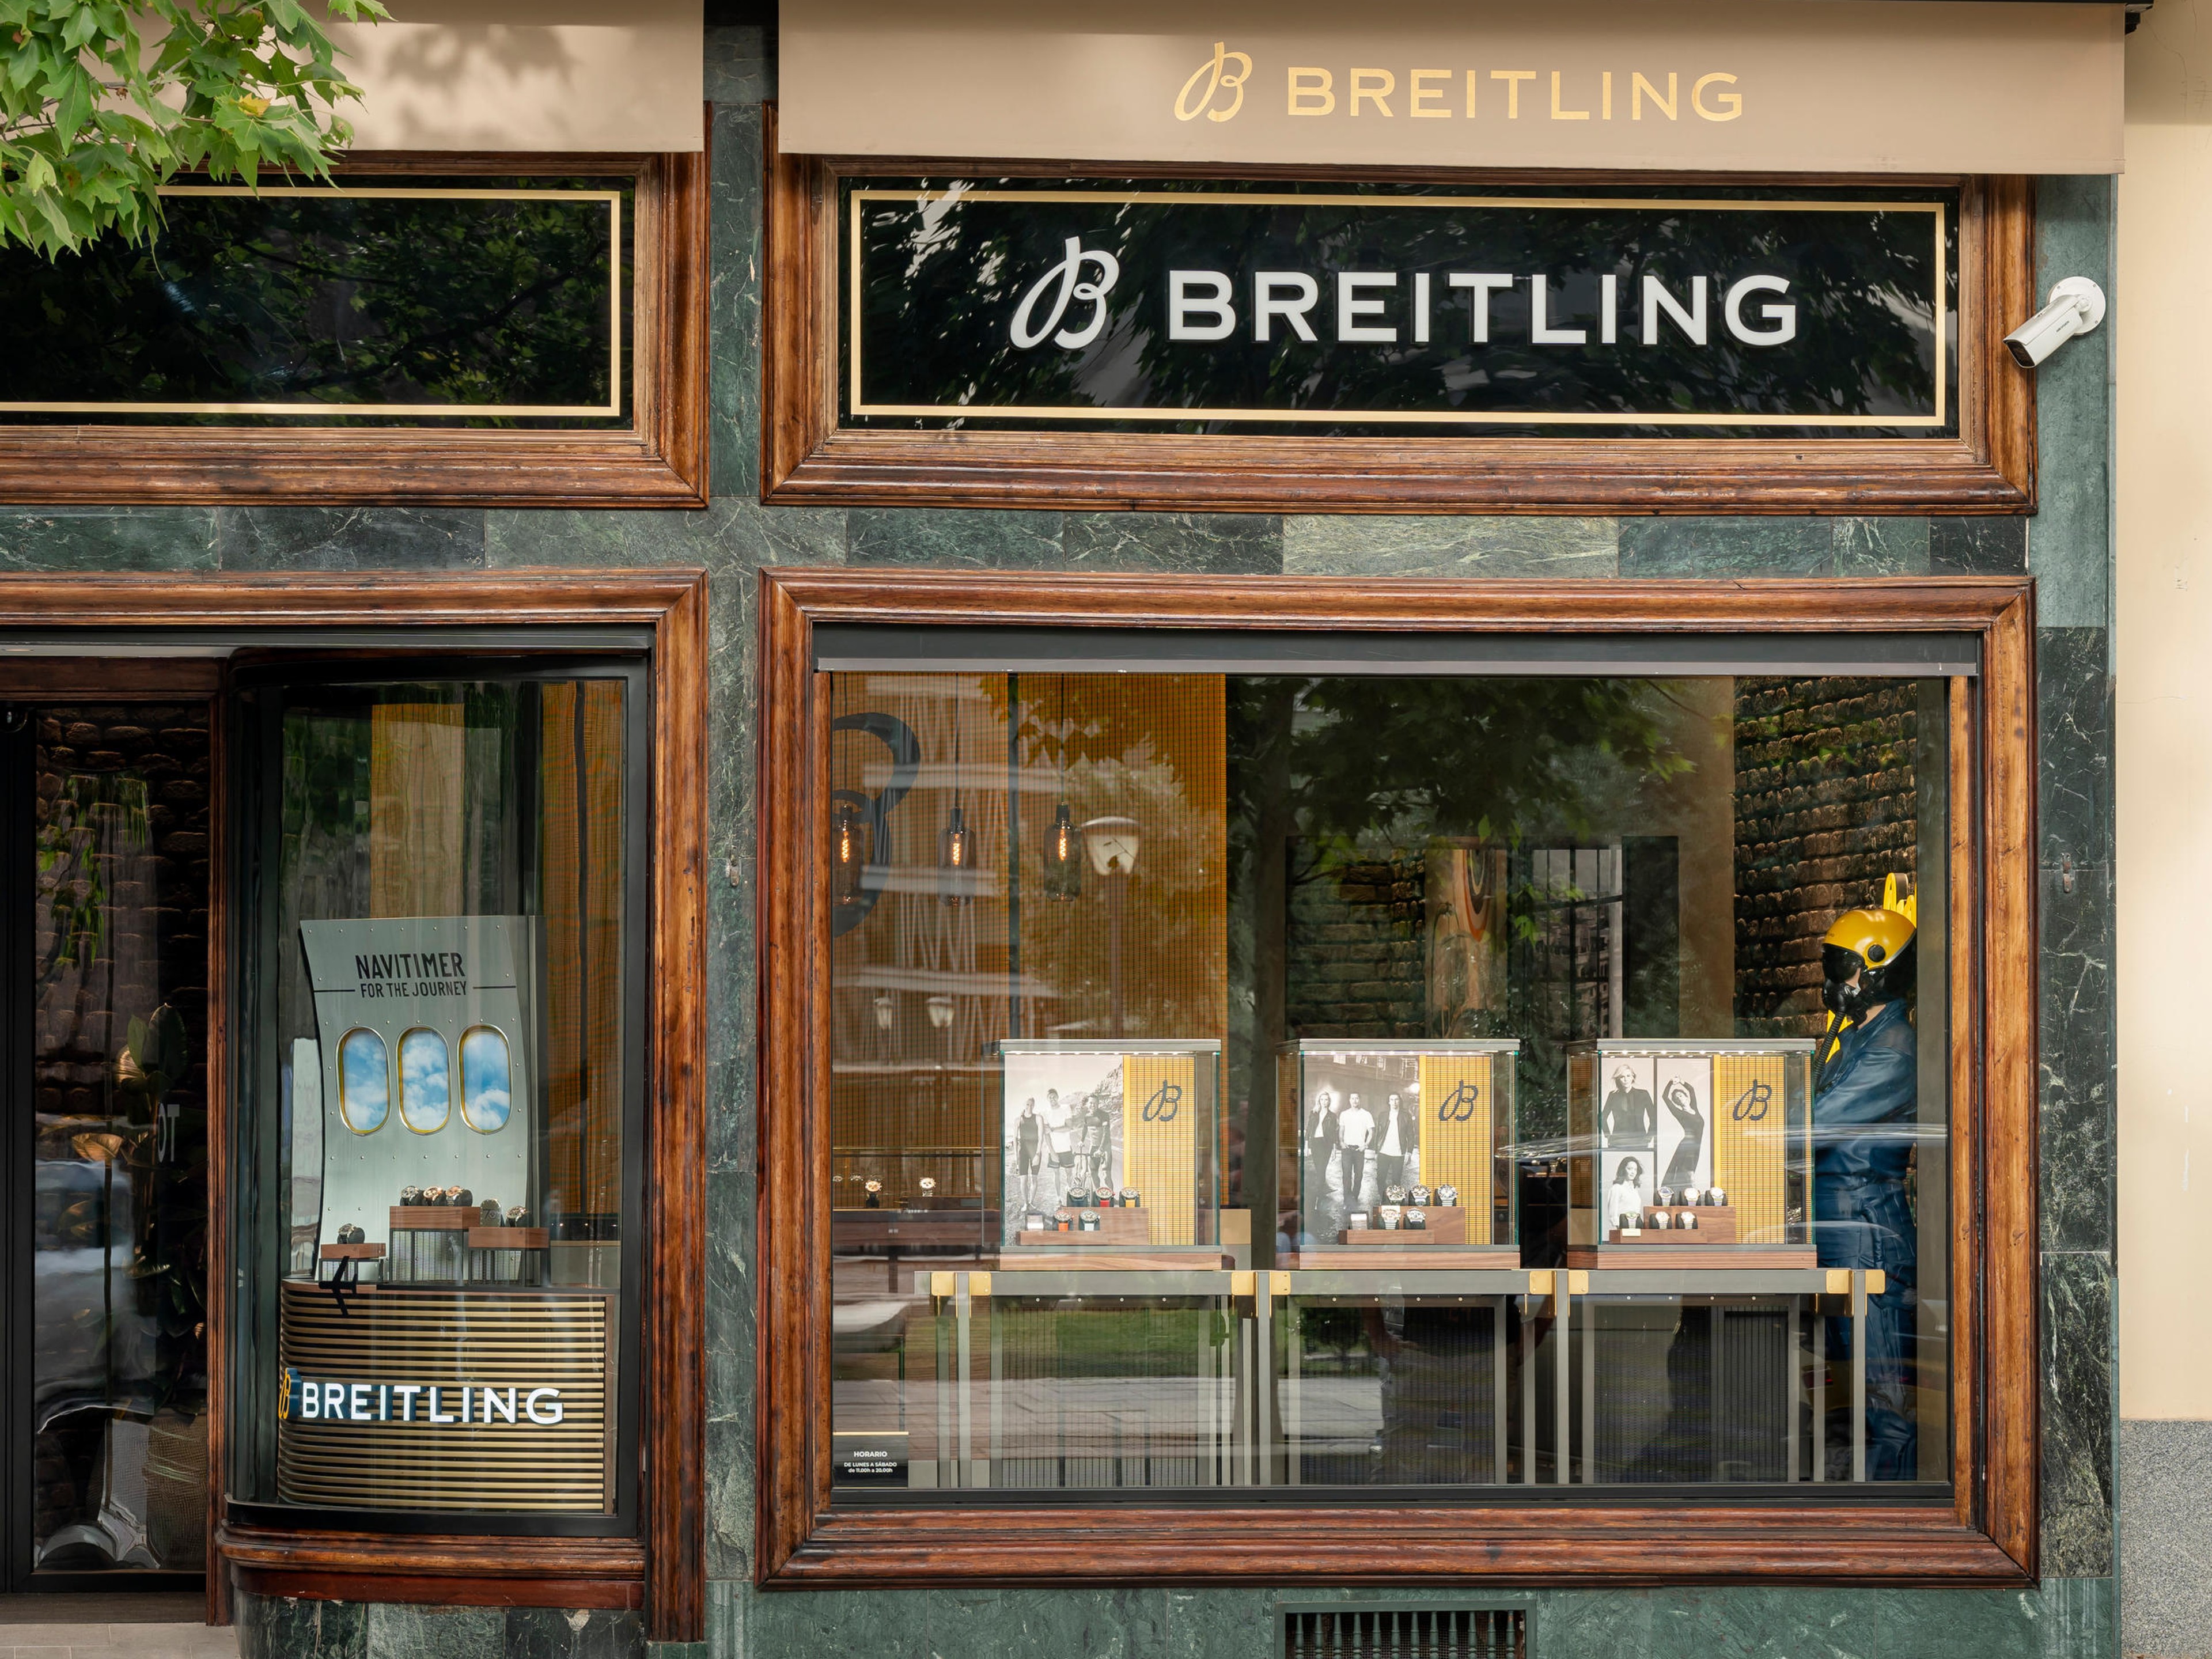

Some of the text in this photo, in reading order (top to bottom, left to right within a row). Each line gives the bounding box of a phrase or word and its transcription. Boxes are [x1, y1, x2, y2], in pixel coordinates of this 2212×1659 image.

[1287, 66, 1743, 122] BREITLING
[1169, 270, 1798, 347] BREITLING
[355, 952, 466, 979] NAVITIMER
[361, 981, 467, 998] FOR THE JOURNEY
[302, 1382, 564, 1425] BREITLING
